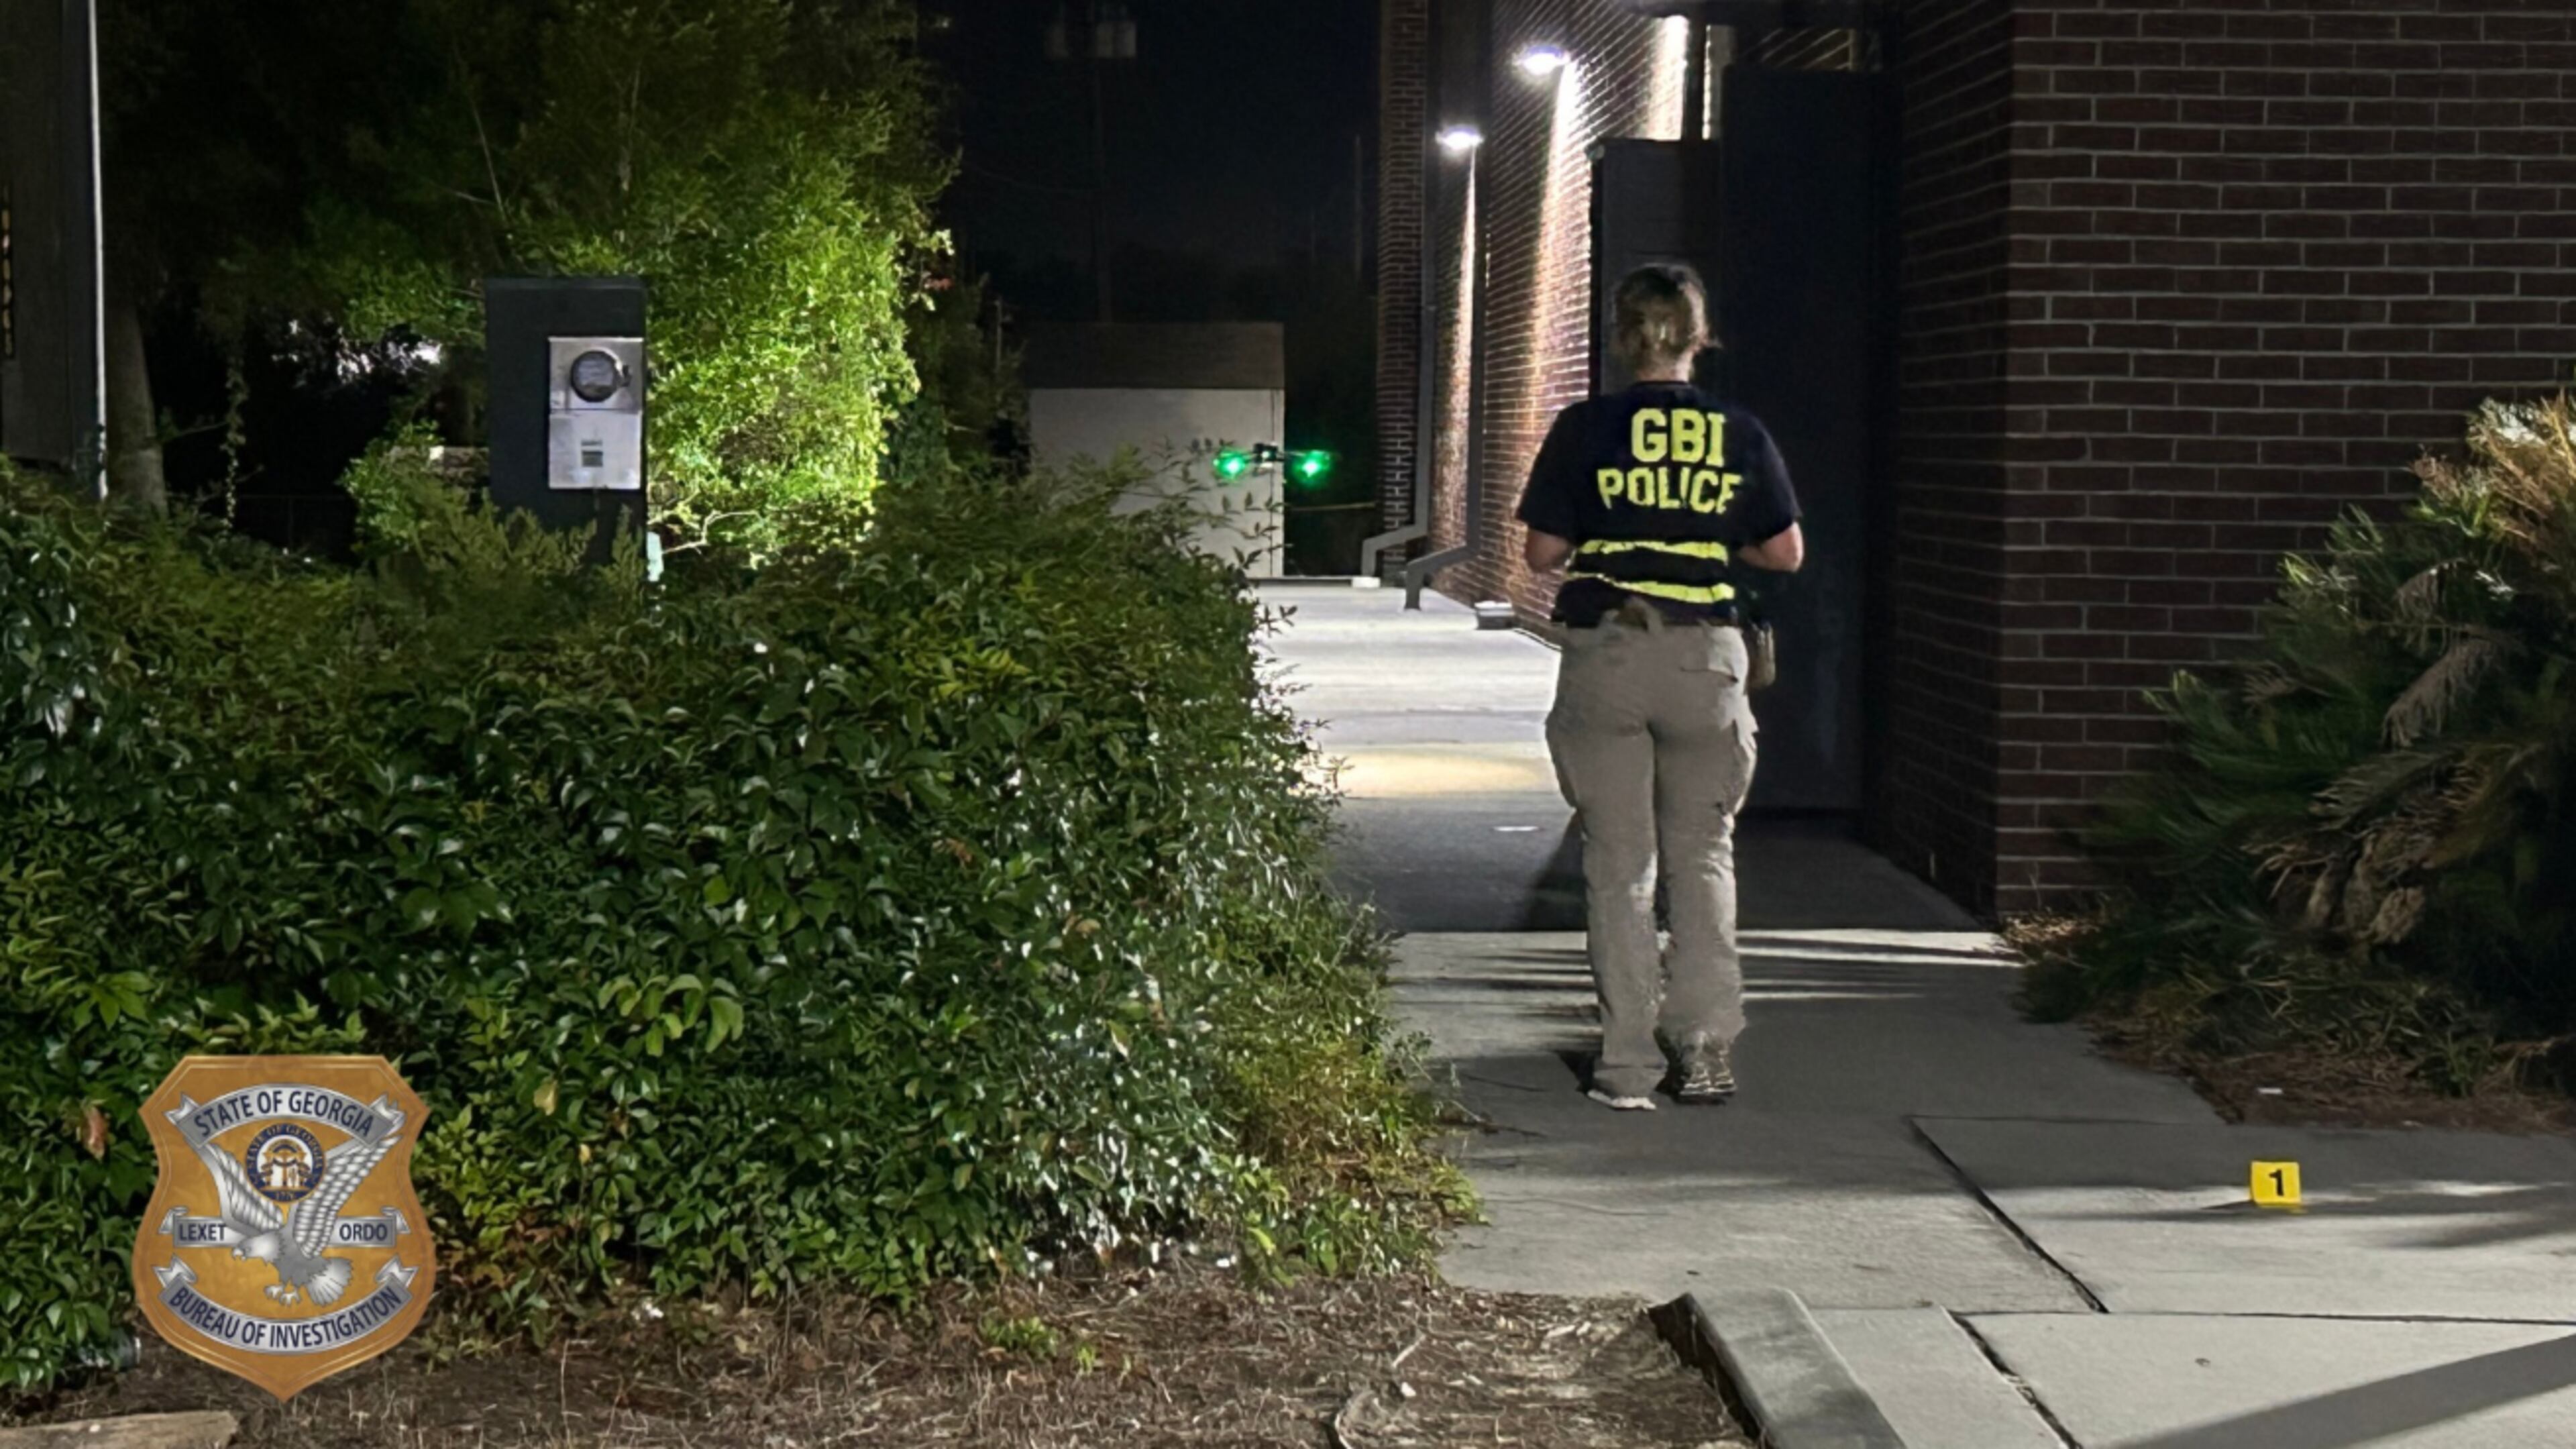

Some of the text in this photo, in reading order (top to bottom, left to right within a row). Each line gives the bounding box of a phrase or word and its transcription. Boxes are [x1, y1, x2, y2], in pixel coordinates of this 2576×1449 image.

[1631, 408, 1726, 467] GBI
[1597, 466, 1743, 514] POLICE
[2269, 1169, 2284, 1197] 1
